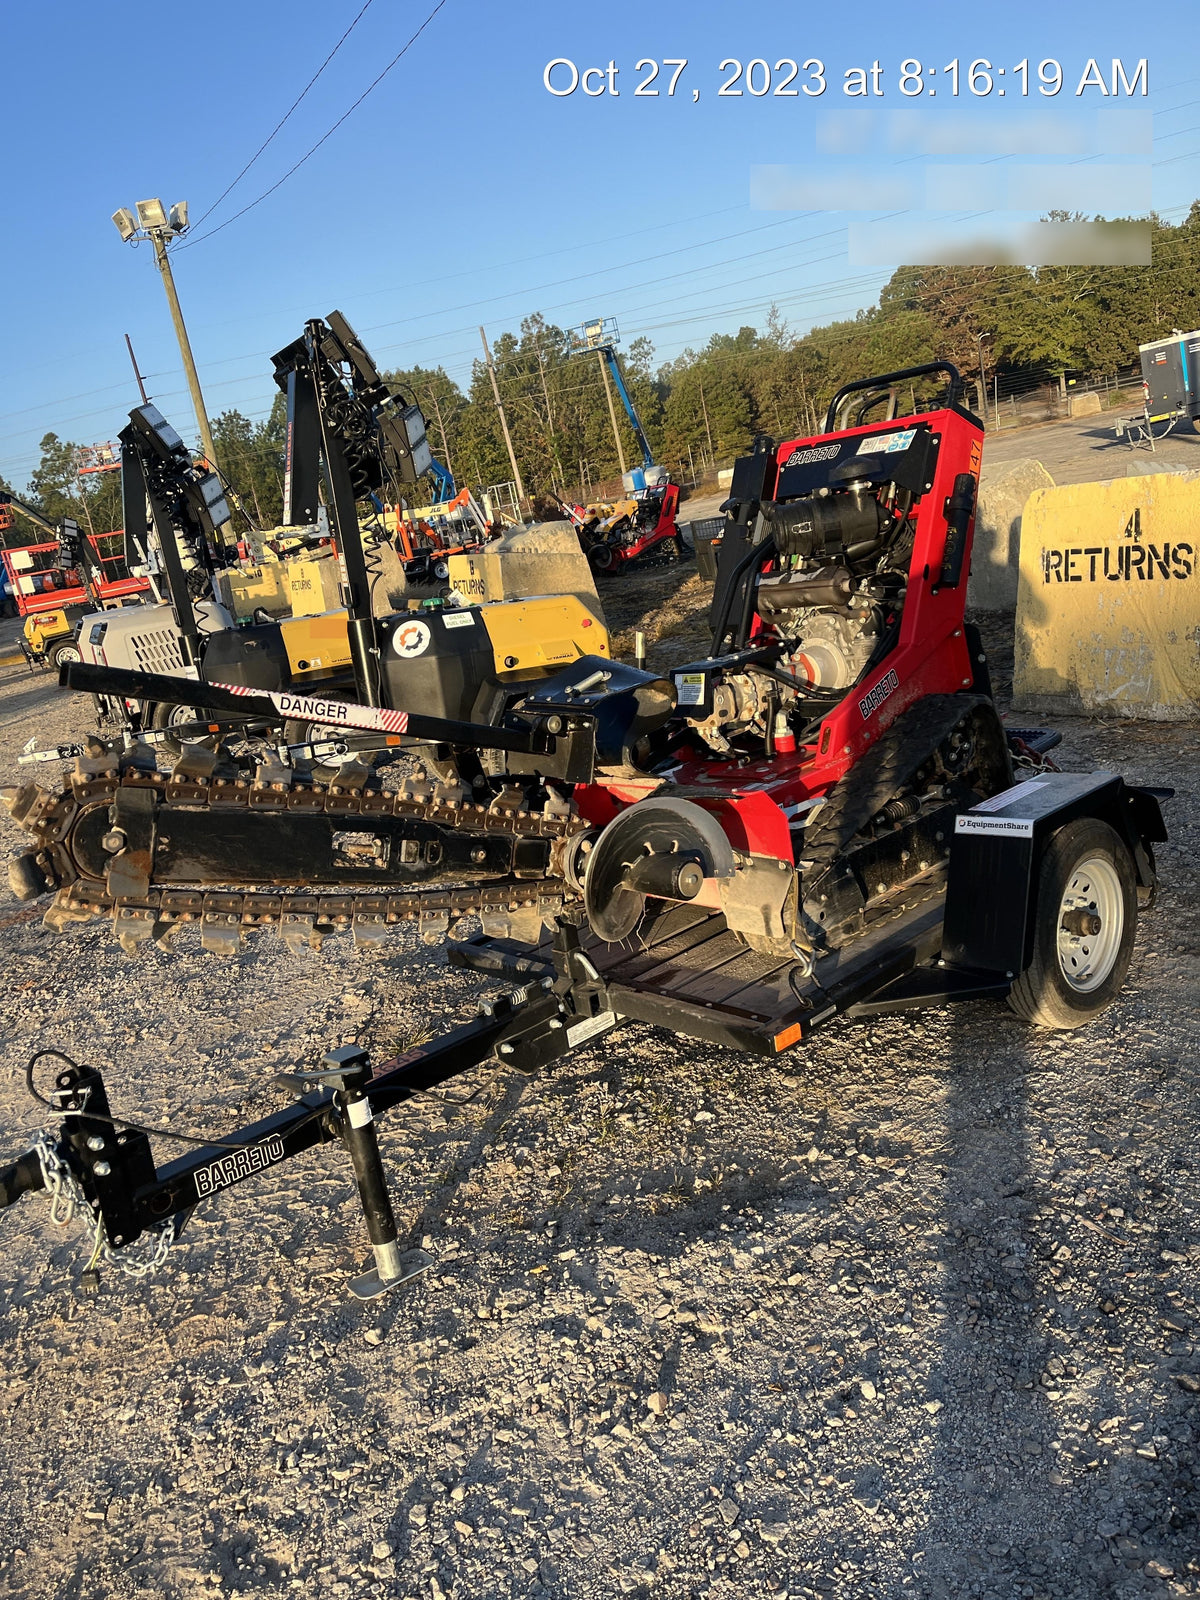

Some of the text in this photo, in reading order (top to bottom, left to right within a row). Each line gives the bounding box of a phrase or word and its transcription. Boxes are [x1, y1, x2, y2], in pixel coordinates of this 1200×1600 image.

[786, 443, 842, 468] BARRETO
[429, 506, 442, 514] JLG
[1124, 507, 1142, 543] 4
[1043, 542, 1194, 584] RETURNS
[291, 579, 312, 592] RETURNS
[453, 578, 486, 596] RETURNS
[858, 668, 900, 721] BARRETO
[280, 696, 348, 720] DANGER
[966, 820, 1030, 831] EquipmentShare
[193, 1132, 286, 1199] BARRETO
